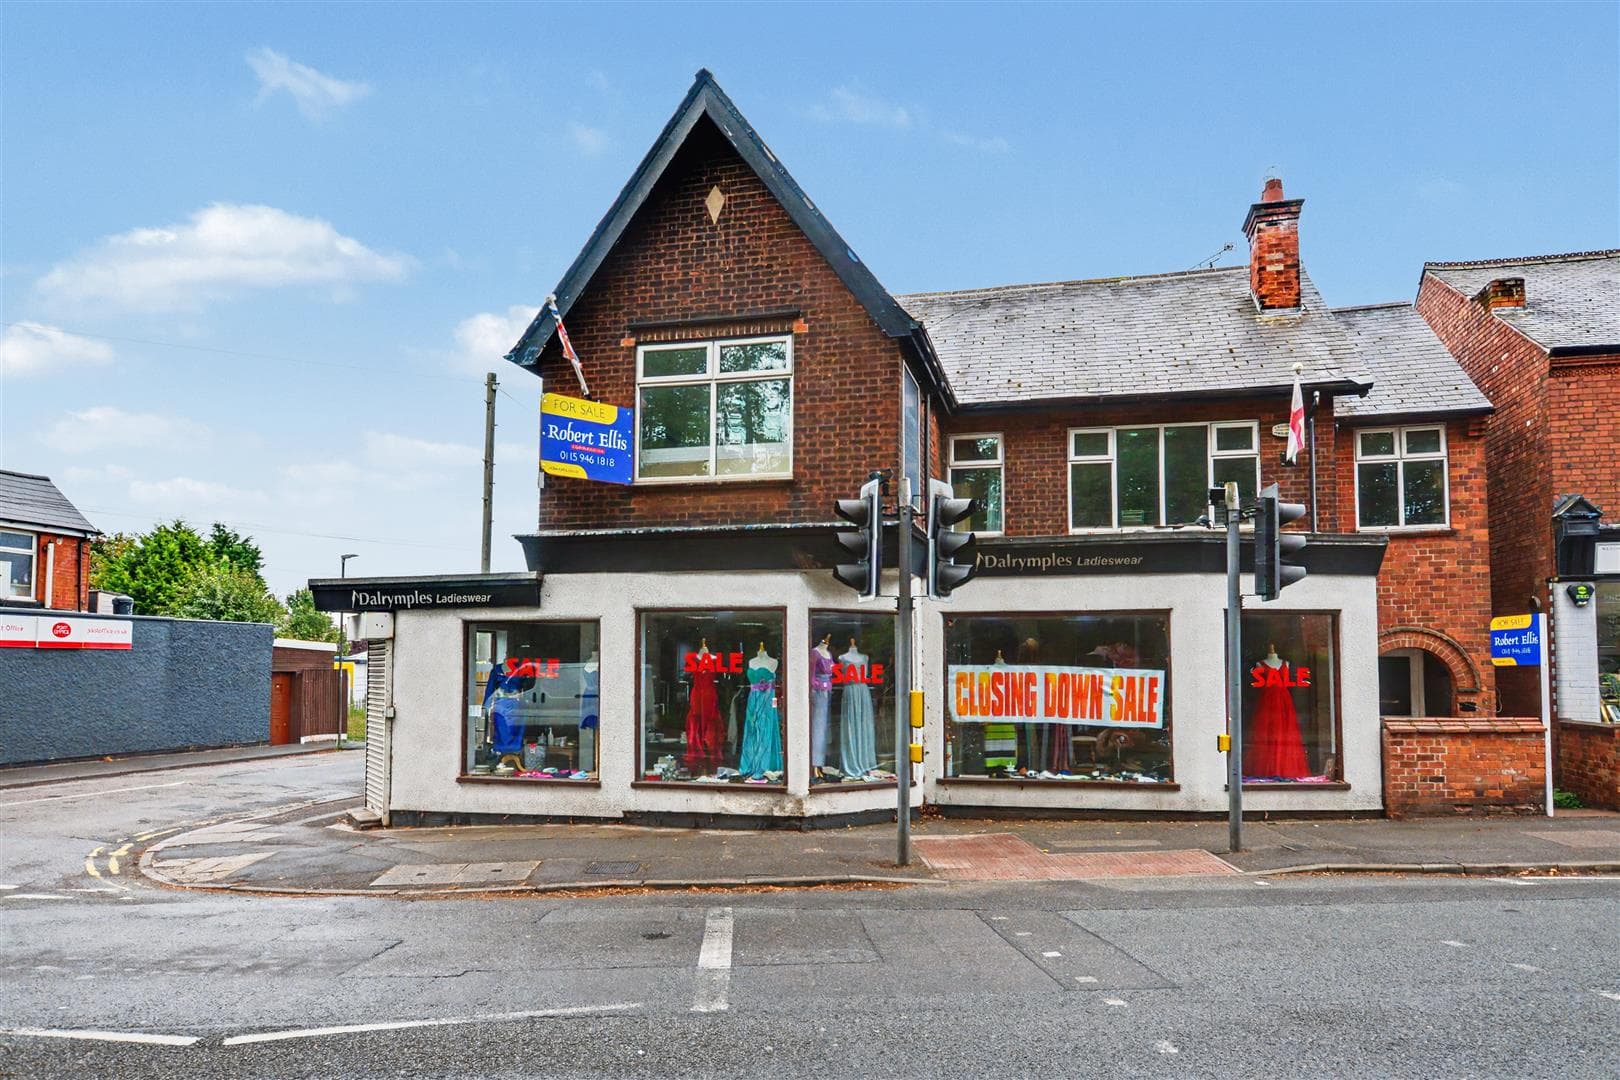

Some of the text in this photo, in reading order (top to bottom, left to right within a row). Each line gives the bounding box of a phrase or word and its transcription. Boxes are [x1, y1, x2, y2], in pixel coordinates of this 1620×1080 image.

[553, 399, 605, 418] FOR SALE
[548, 422, 594, 445] Robert
[598, 430, 627, 450] Ellis
[560, 450, 615, 467] 0115 946 1818
[984, 553, 1143, 571] Dalrymples Ladieswear
[360, 590, 492, 608] Dalrymples Ladieswear
[1494, 631, 1539, 646] Robert Ellis
[505, 657, 560, 679] SALE
[684, 651, 743, 673] SALE
[831, 663, 885, 684] SALE
[1251, 666, 1311, 688] SALE
[955, 671, 1158, 722] CLOSING DOWN SALE
